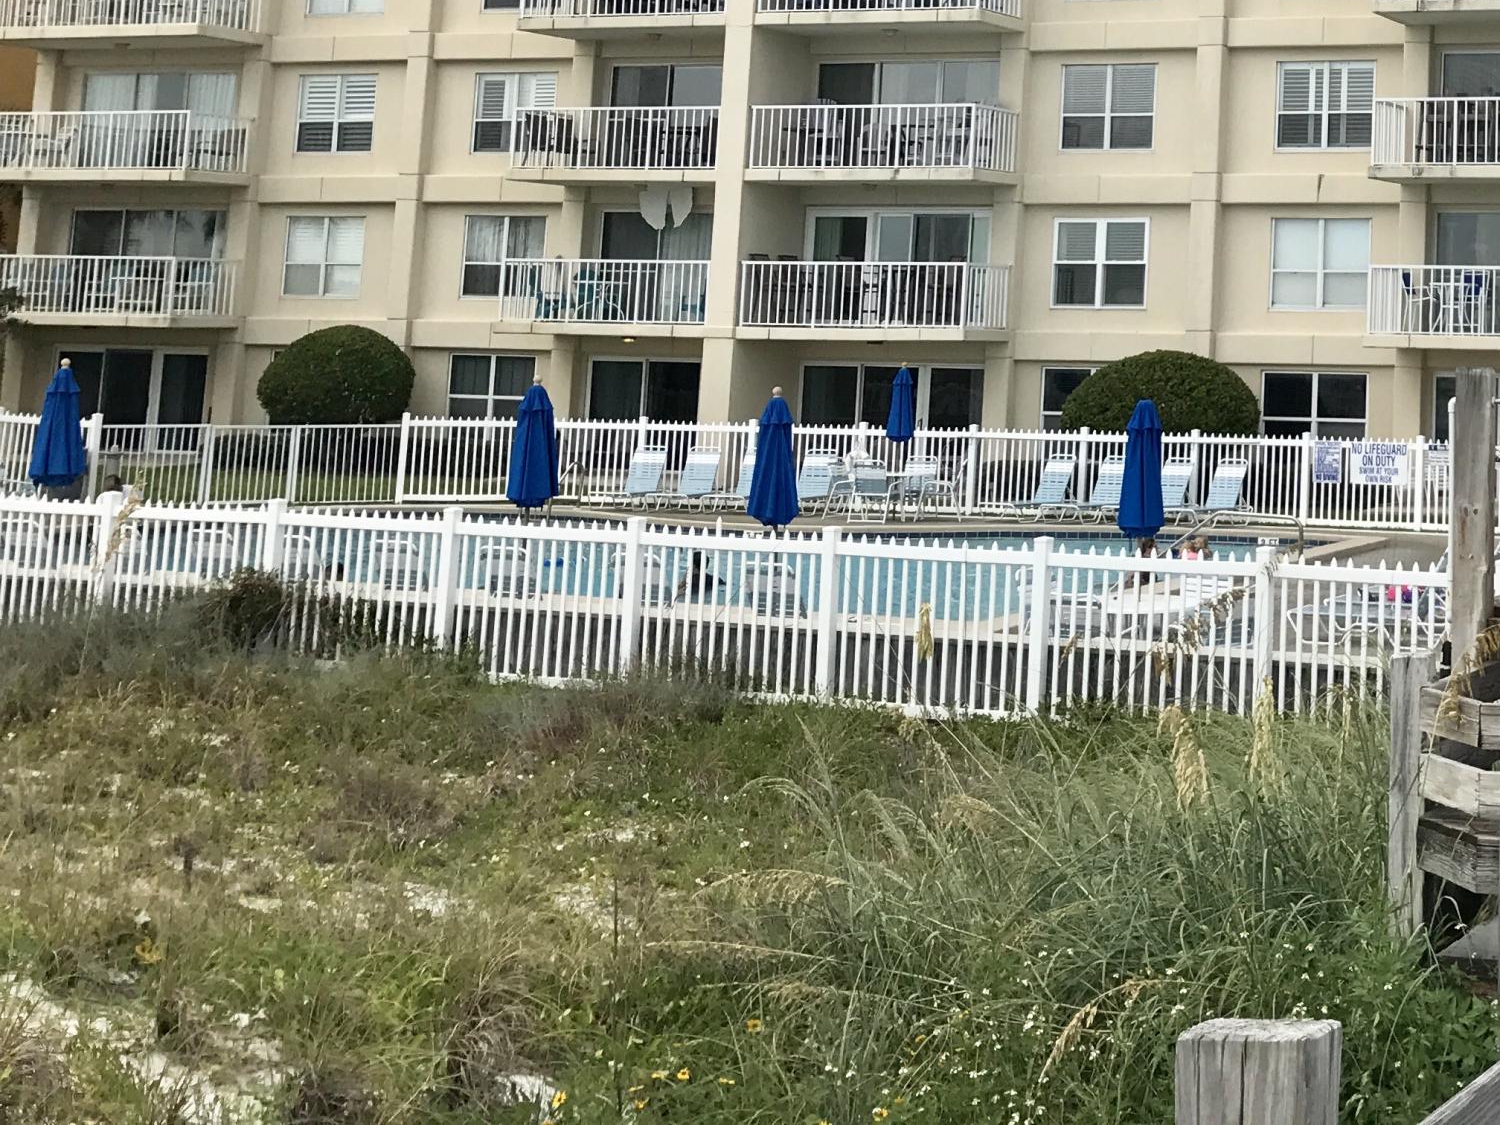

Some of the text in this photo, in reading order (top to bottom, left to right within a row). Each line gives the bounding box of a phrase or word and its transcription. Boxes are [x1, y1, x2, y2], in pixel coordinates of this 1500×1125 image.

[1351, 442, 1407, 456] NO LIFEGUARD
[1362, 455, 1396, 467] ON DUTY
[1359, 467, 1399, 476] SWIM AT YOUR
[1365, 475, 1392, 483] OWN RISK
